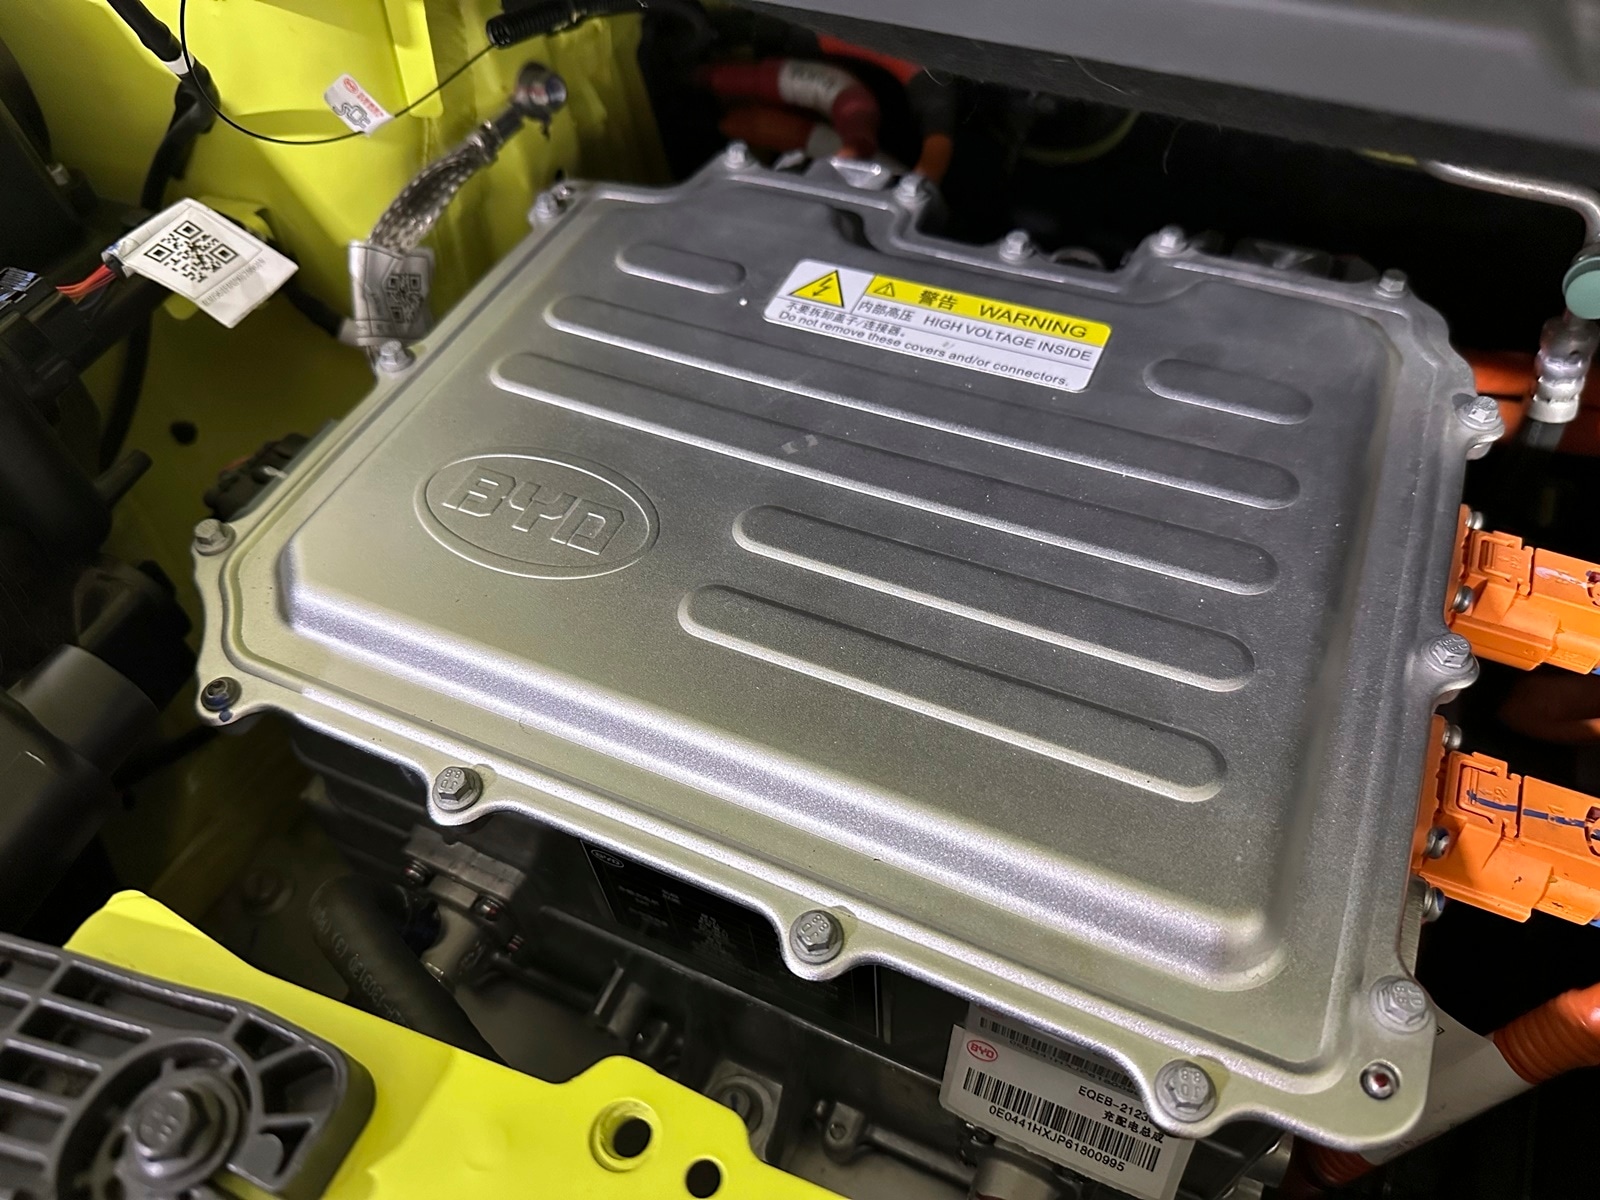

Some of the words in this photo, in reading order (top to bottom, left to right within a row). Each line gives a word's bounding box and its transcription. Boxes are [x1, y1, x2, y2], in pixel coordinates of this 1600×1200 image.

[856, 300, 915, 322] 内部高压
[919, 290, 957, 311] 警告
[923, 315, 963, 333] HIGH
[966, 324, 1036, 349] VOLTAGE
[1037, 340, 1093, 362] INSIDE
[980, 304, 1088, 339] WARNING
[778, 311, 796, 323] Do
[797, 316, 819, 328] not
[820, 321, 865, 339] remove
[867, 332, 901, 348] these
[904, 342, 946, 358] covers
[948, 351, 991, 368] and/or
[992, 360, 1070, 387] connectors.
[439, 463, 628, 557] BYD
[969, 1042, 996, 1059] BYD
[1078, 1085, 1153, 1124] EQEB-2123
[988, 1104, 1126, 1172] 0E0441HXJP61800995
[1101, 1109, 1164, 1144] 充配电总成
